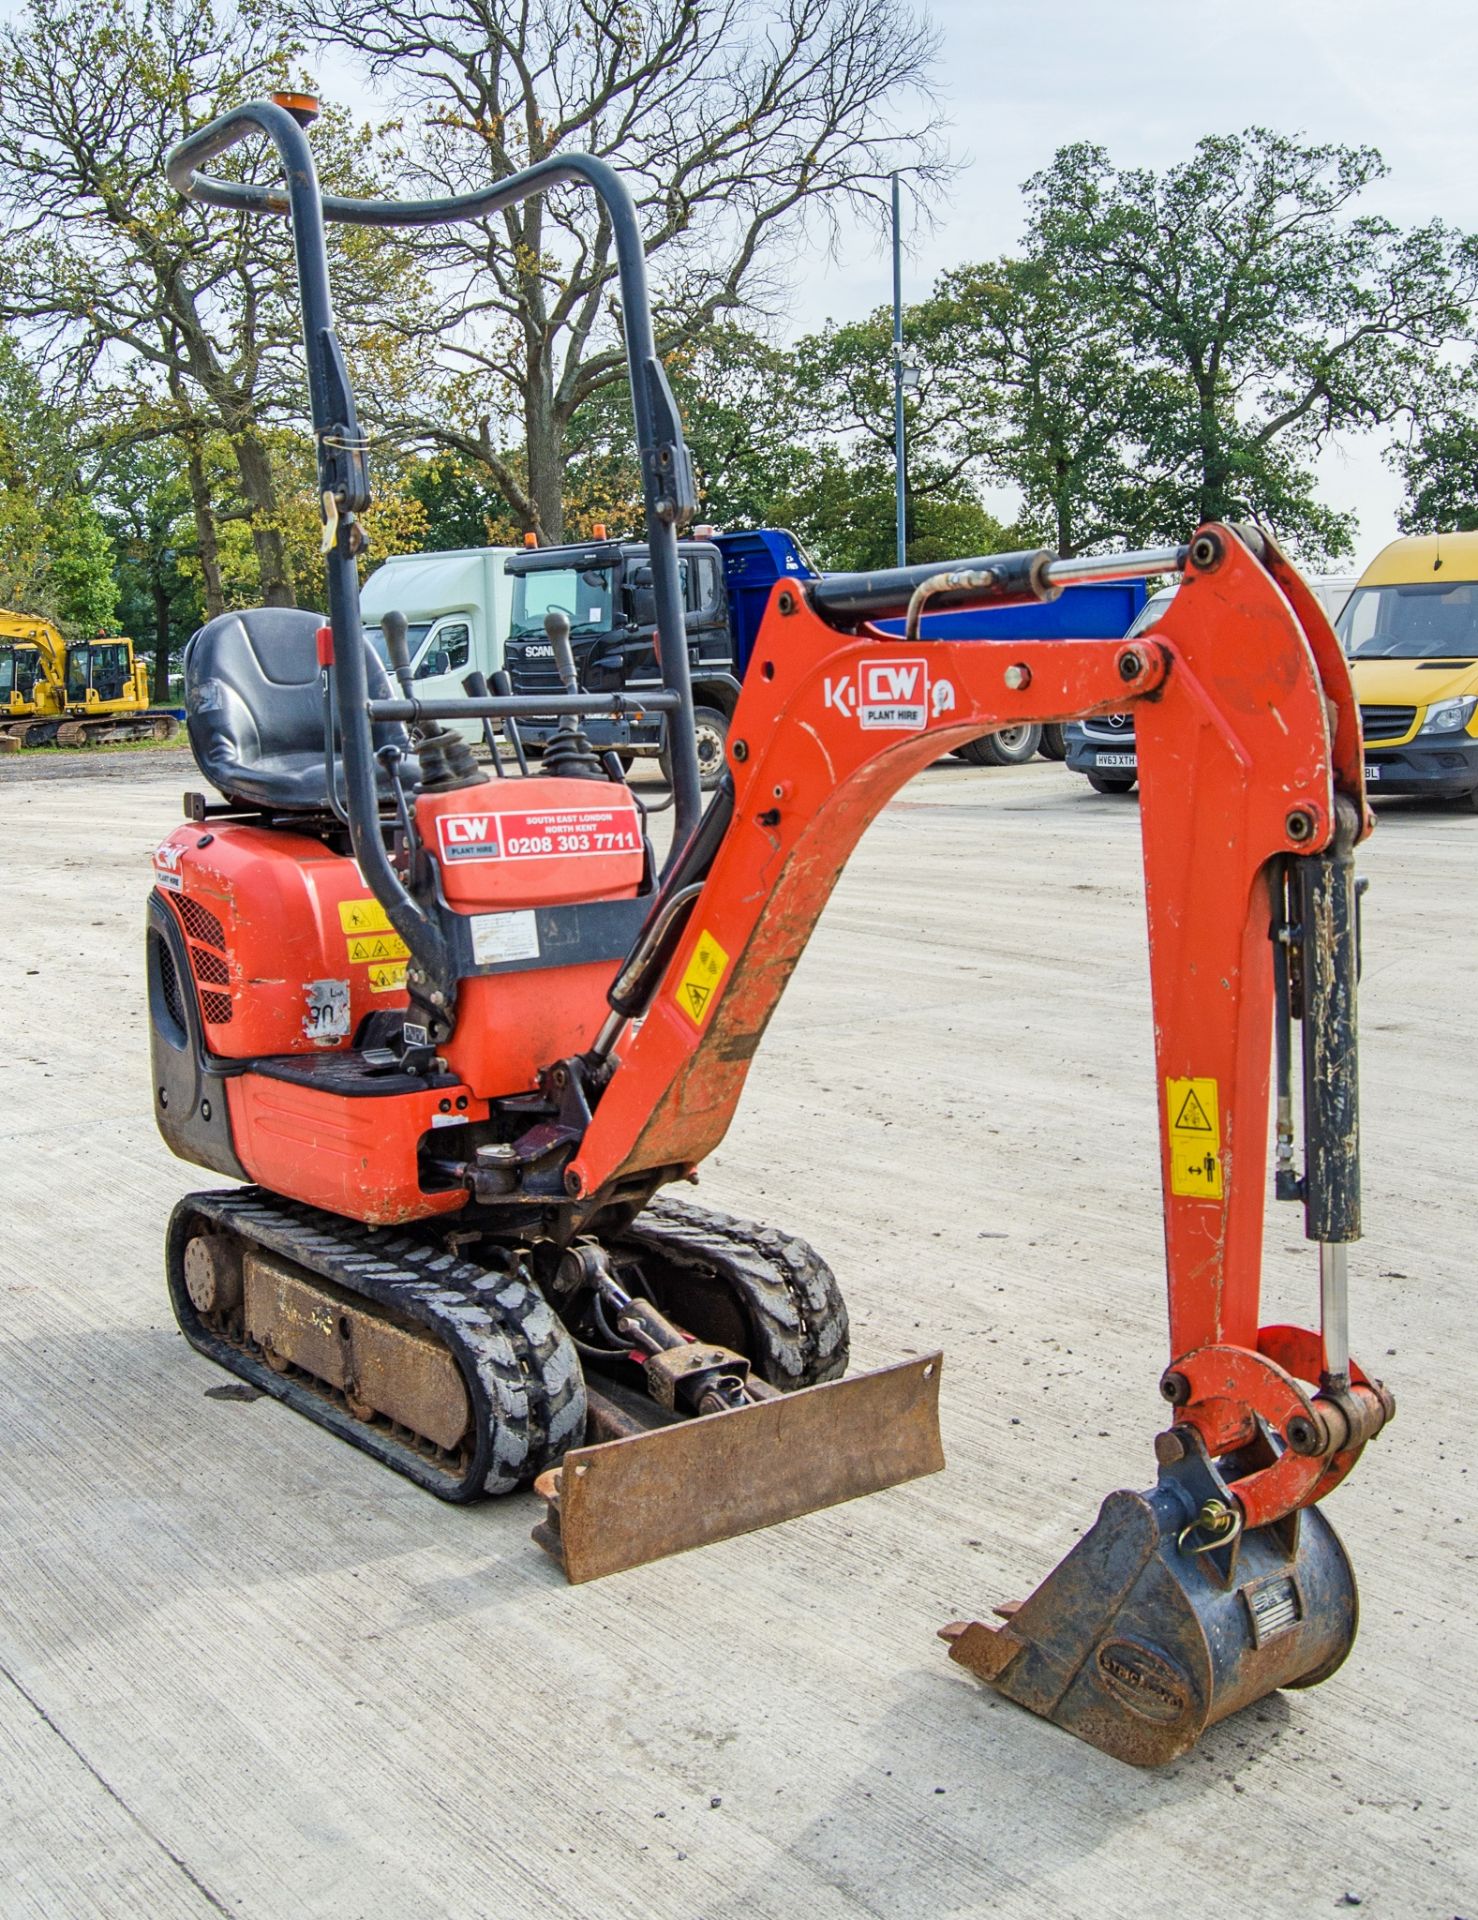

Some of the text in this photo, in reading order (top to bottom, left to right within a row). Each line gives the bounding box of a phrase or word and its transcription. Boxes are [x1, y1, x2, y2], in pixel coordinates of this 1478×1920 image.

[525, 646, 555, 657] SCANI
[868, 667, 919, 700] CW
[868, 710, 918, 720] PLANT HIRE
[1098, 755, 1135, 765] HV63 XTH
[525, 813, 613, 825] SOUTH EAST LONDON
[447, 817, 489, 842] CW
[545, 824, 597, 834] NORTH KENT
[507, 832, 635, 854] 0208 303 7711
[451, 846, 475, 855] PLANT
